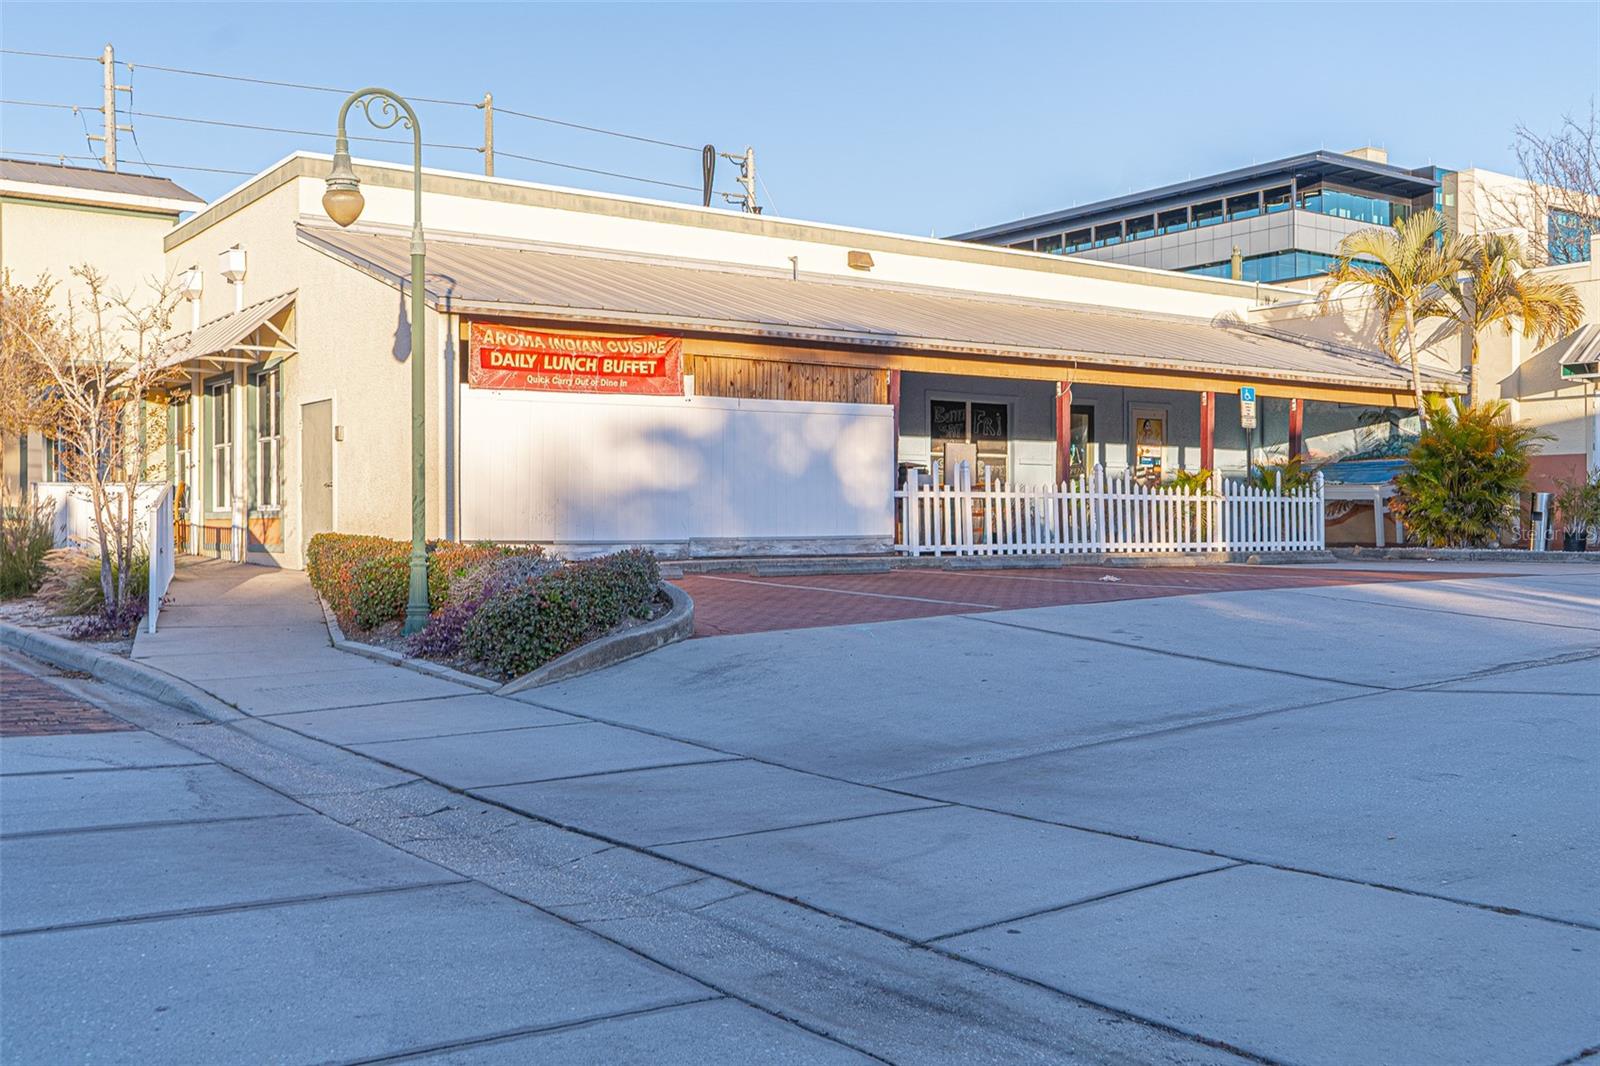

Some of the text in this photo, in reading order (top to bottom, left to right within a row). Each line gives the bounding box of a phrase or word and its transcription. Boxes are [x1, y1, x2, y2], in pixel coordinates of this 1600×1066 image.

[483, 329, 666, 354] AROMA INDIAN CUISINE
[490, 351, 657, 374] DAILY LUNCH BUFFET
[527, 374, 550, 384] Quick
[552, 375, 573, 386] Carry
[575, 378, 589, 386] Out
[600, 378, 618, 387] Dine
